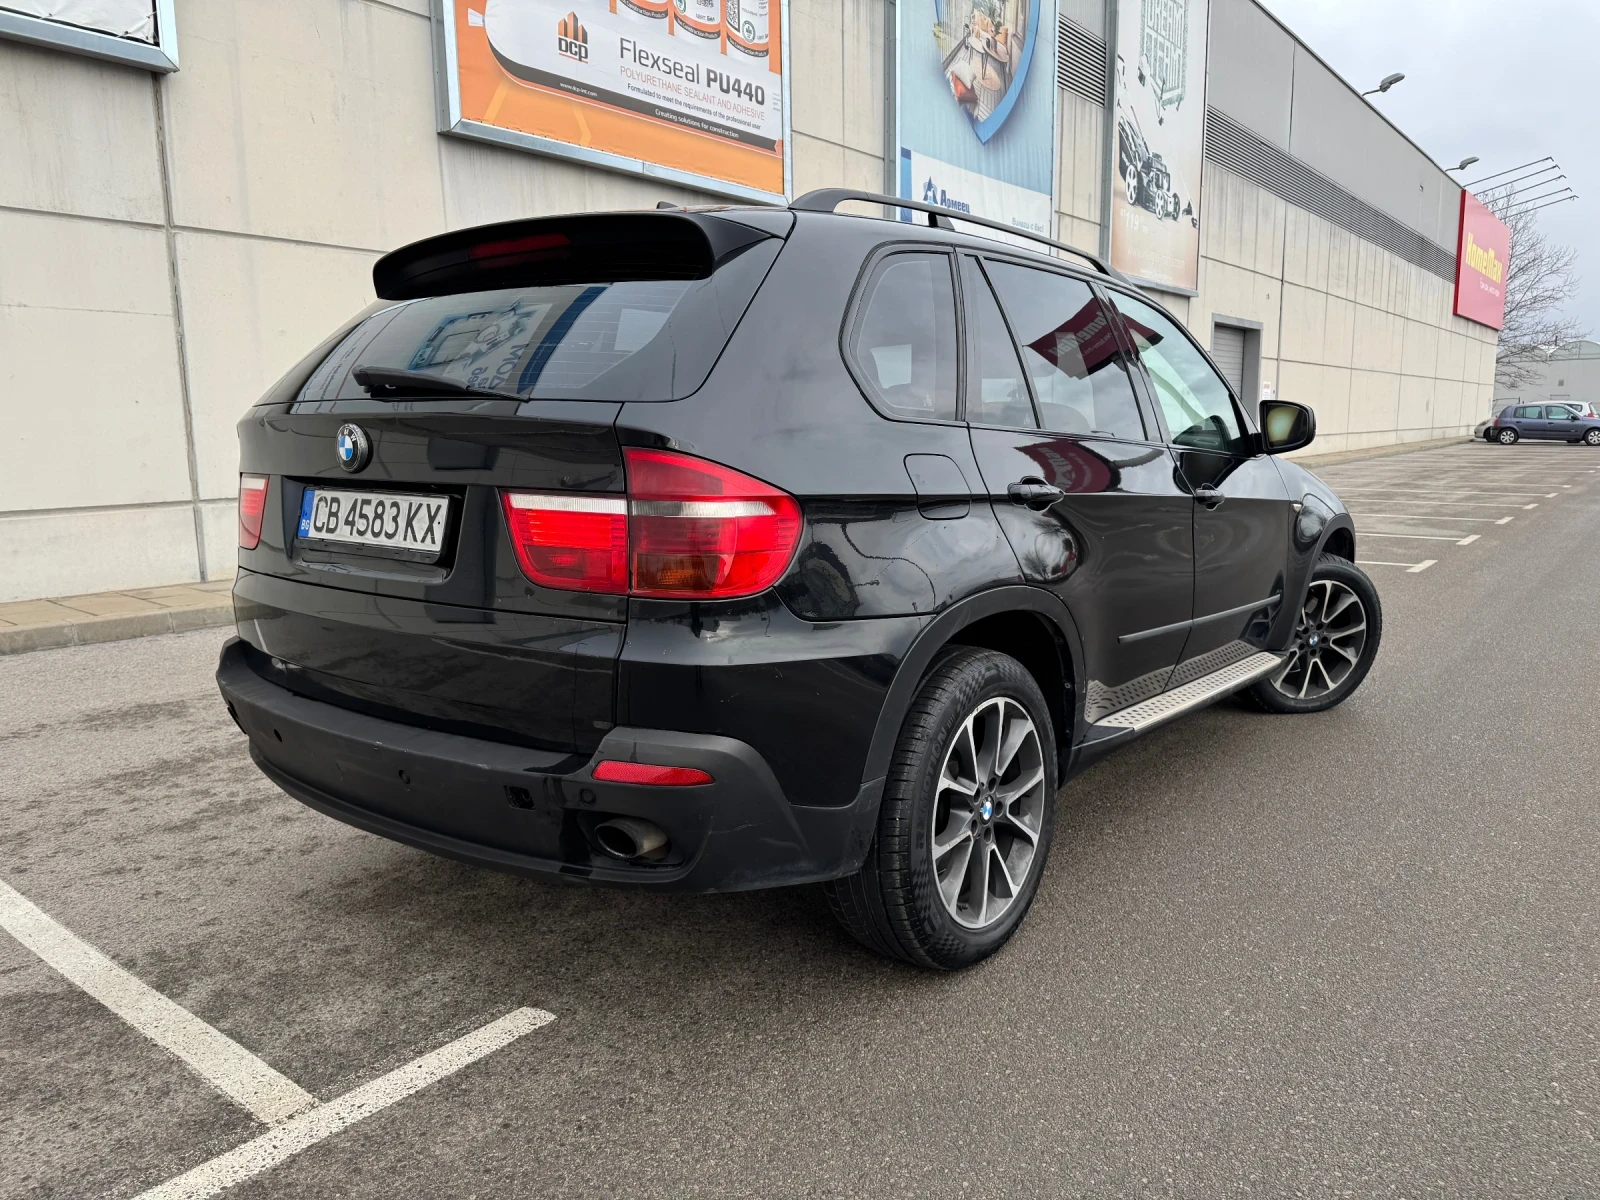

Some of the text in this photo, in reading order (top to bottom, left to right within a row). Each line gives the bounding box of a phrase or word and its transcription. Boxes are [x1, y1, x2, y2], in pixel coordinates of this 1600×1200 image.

[620, 37, 700, 85] Flexseal
[706, 67, 765, 106] PU440
[620, 65, 765, 121] POLYURETHANE SEALANT AND ADHESIVE
[627, 82, 656, 98] Formulated
[656, 91, 661, 99] to
[662, 95, 674, 104] meet
[674, 97, 682, 106] the
[683, 101, 712, 117] requirements
[713, 108, 718, 117] of
[725, 112, 751, 129] professional
[751, 121, 761, 130] user
[655, 108, 739, 138] Creating solutions for construction
[940, 189, 970, 214] Армеец
[1465, 231, 1503, 284] HomeMax
[300, 519, 310, 531] BG
[313, 495, 442, 545] CB 4583 KX
